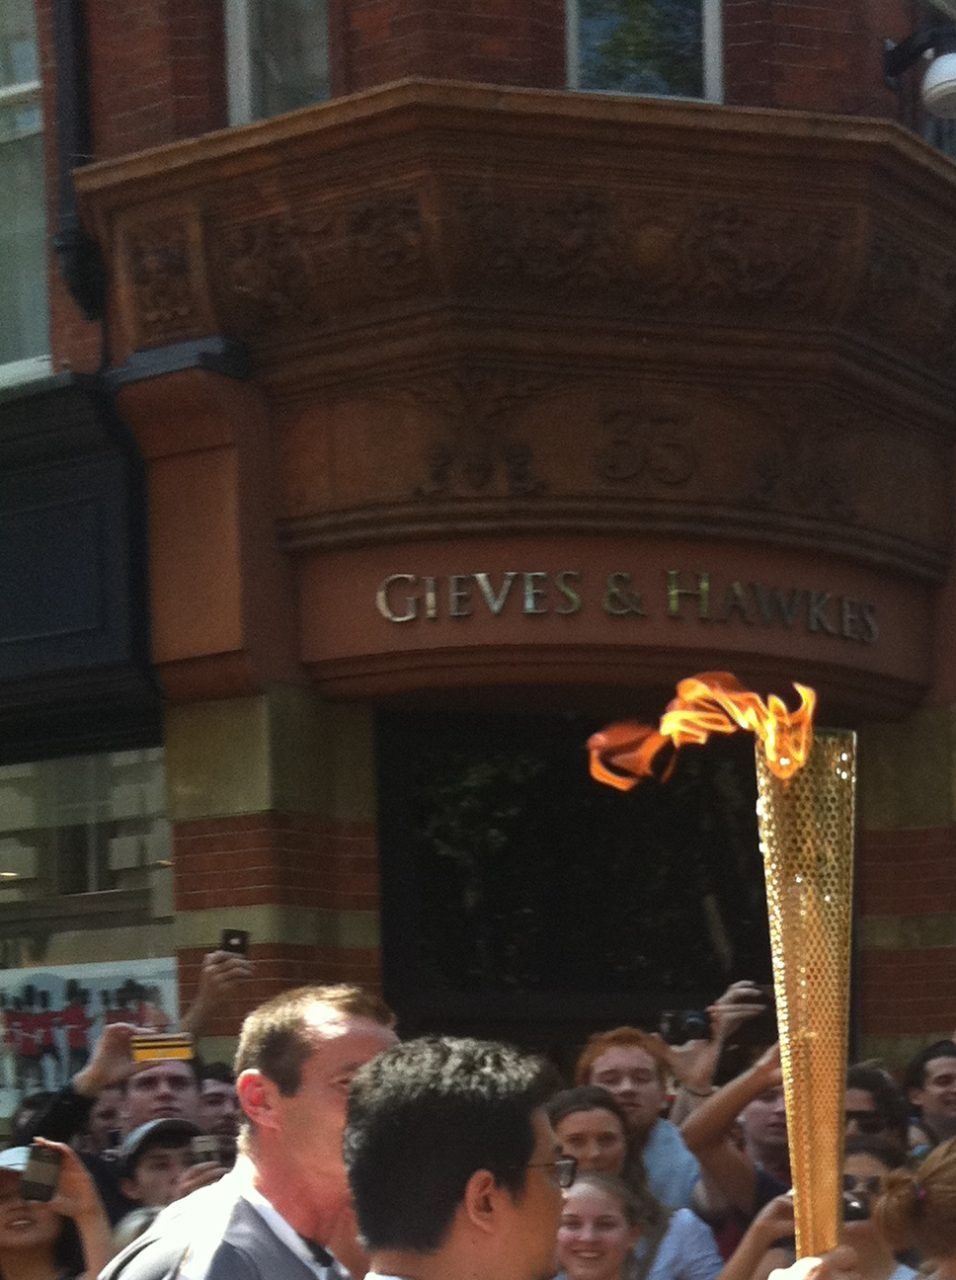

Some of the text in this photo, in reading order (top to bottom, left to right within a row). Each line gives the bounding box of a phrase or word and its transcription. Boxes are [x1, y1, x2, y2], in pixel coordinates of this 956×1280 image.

[376, 570, 880, 644] GIEVES & HAWKES
